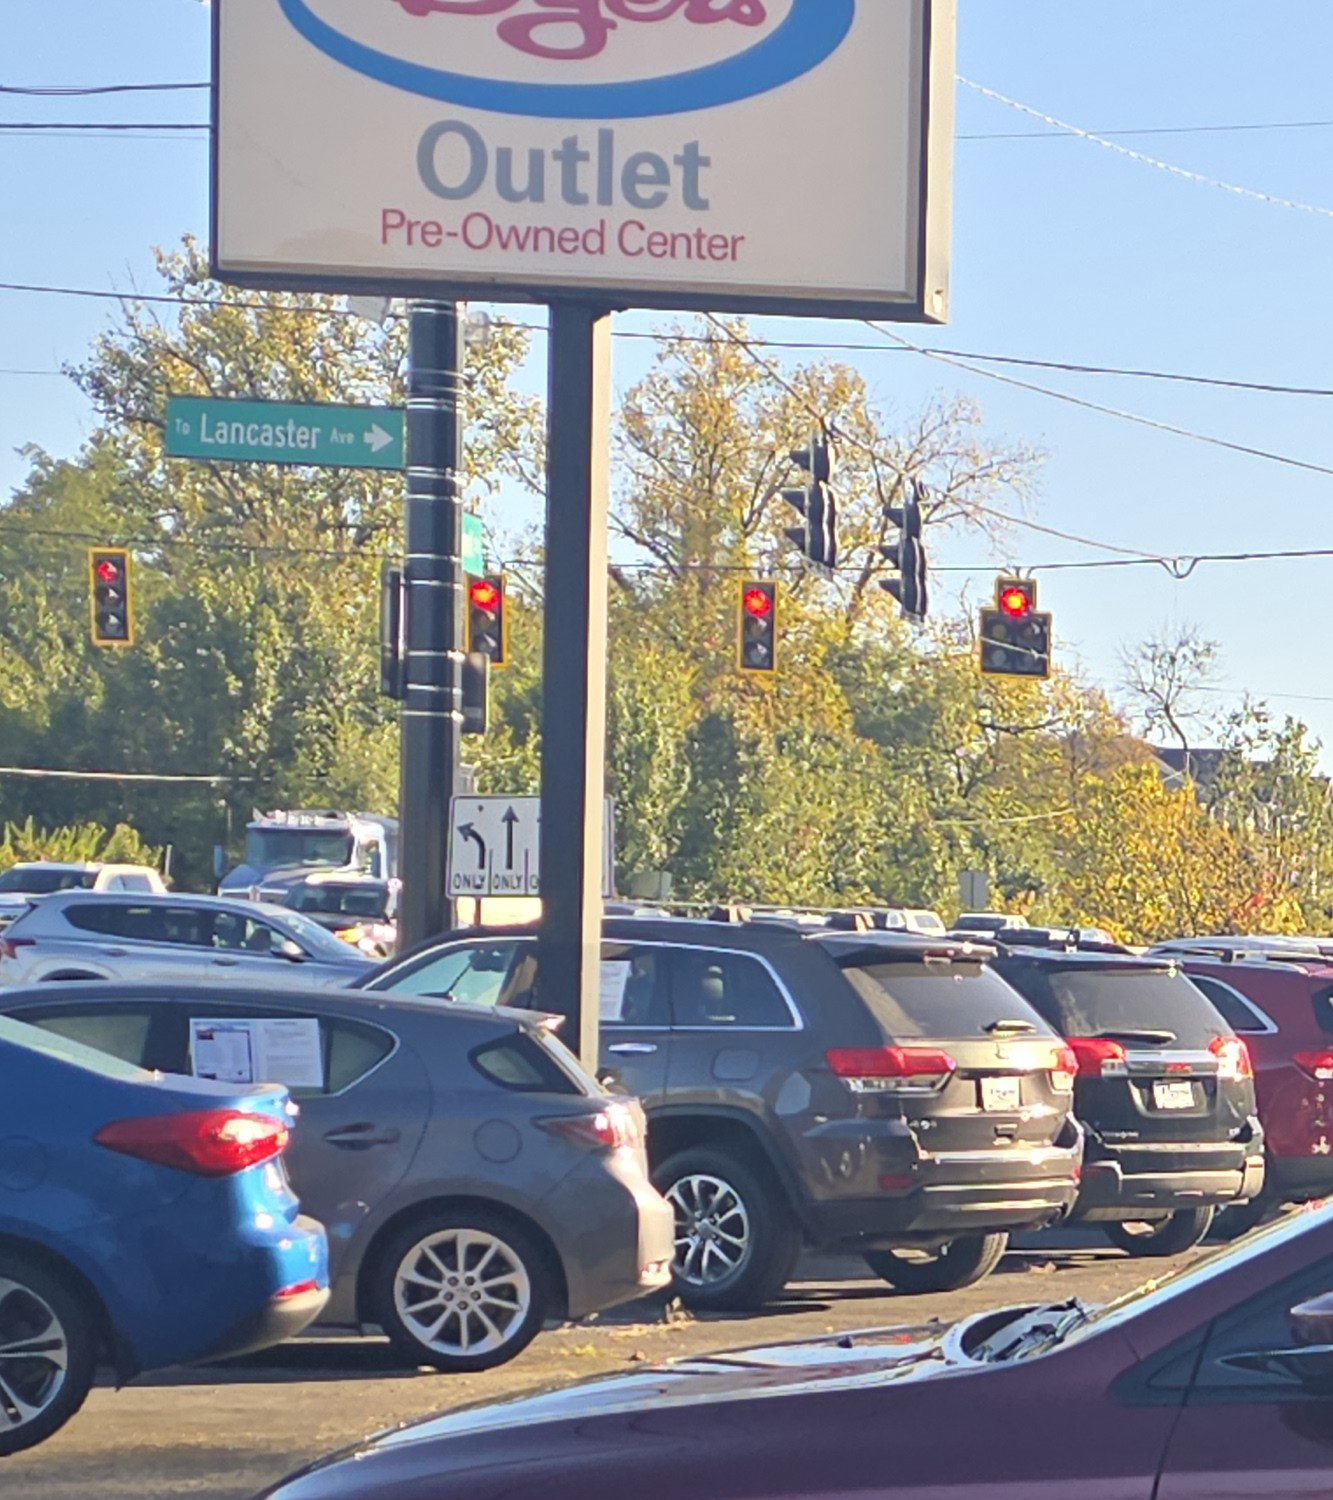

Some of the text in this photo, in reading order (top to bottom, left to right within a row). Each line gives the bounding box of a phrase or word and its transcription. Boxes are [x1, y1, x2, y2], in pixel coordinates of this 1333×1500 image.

[416, 119, 711, 211] Outlet
[381, 208, 745, 262] Pre-Owned Center
[174, 412, 355, 450] To Lancaster Ave
[452, 873, 485, 890] ONLY
[493, 873, 522, 891] ONLY
